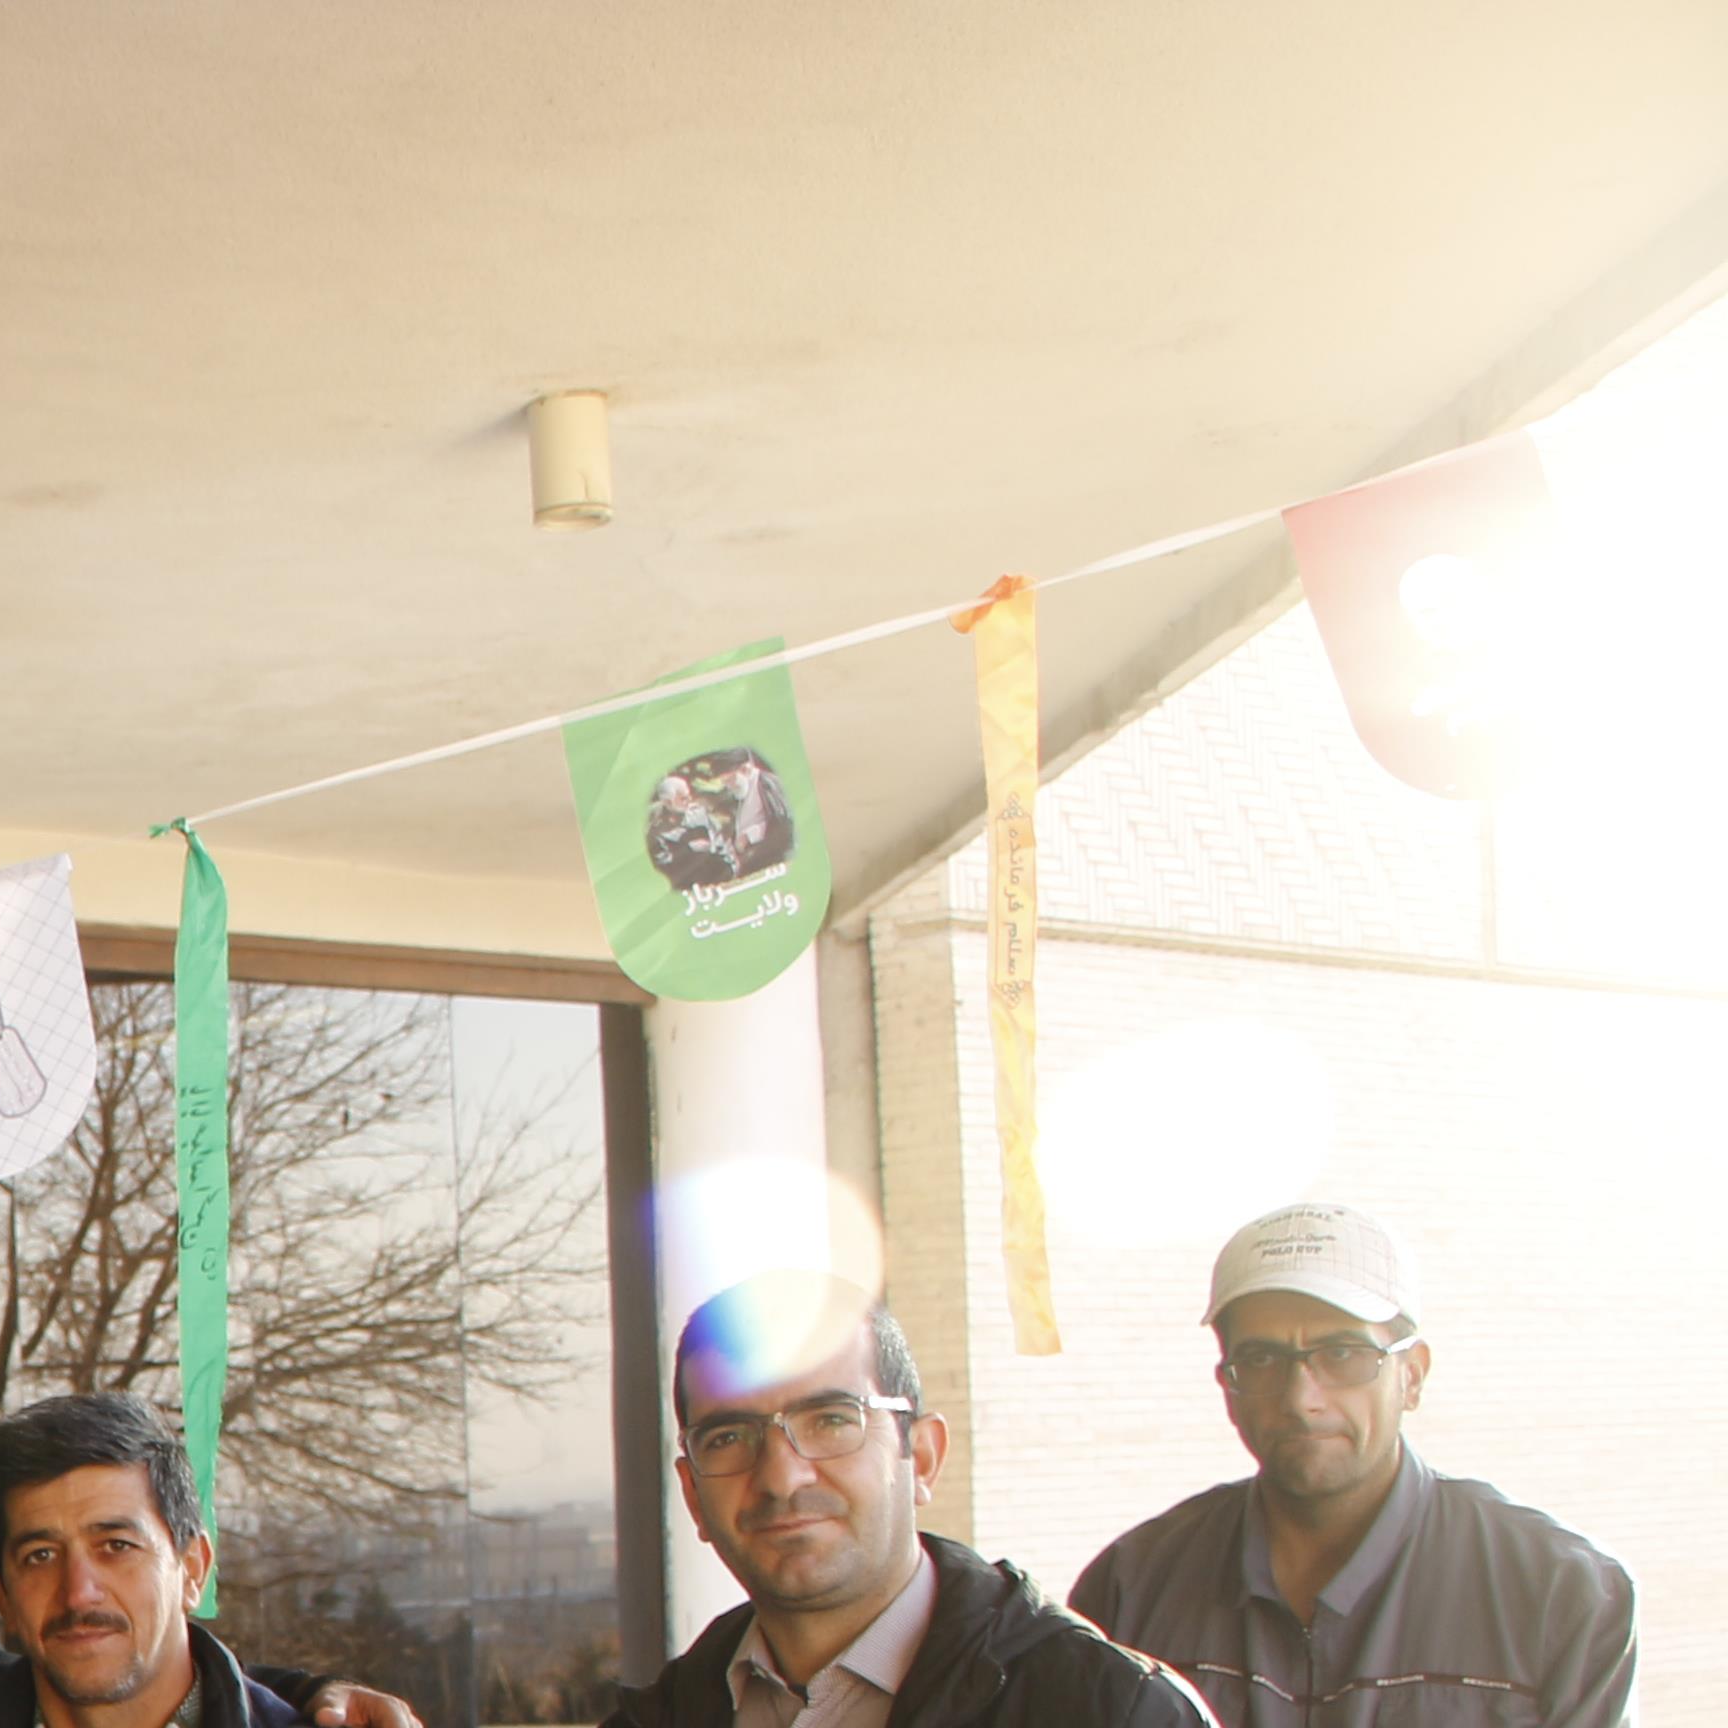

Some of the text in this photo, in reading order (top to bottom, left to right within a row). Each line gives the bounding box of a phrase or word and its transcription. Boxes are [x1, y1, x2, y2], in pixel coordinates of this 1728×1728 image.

[681, 862, 787, 917] سرباز
[691, 890, 800, 939] ولایت
[1003, 828, 1025, 976] سلام فرمانده
